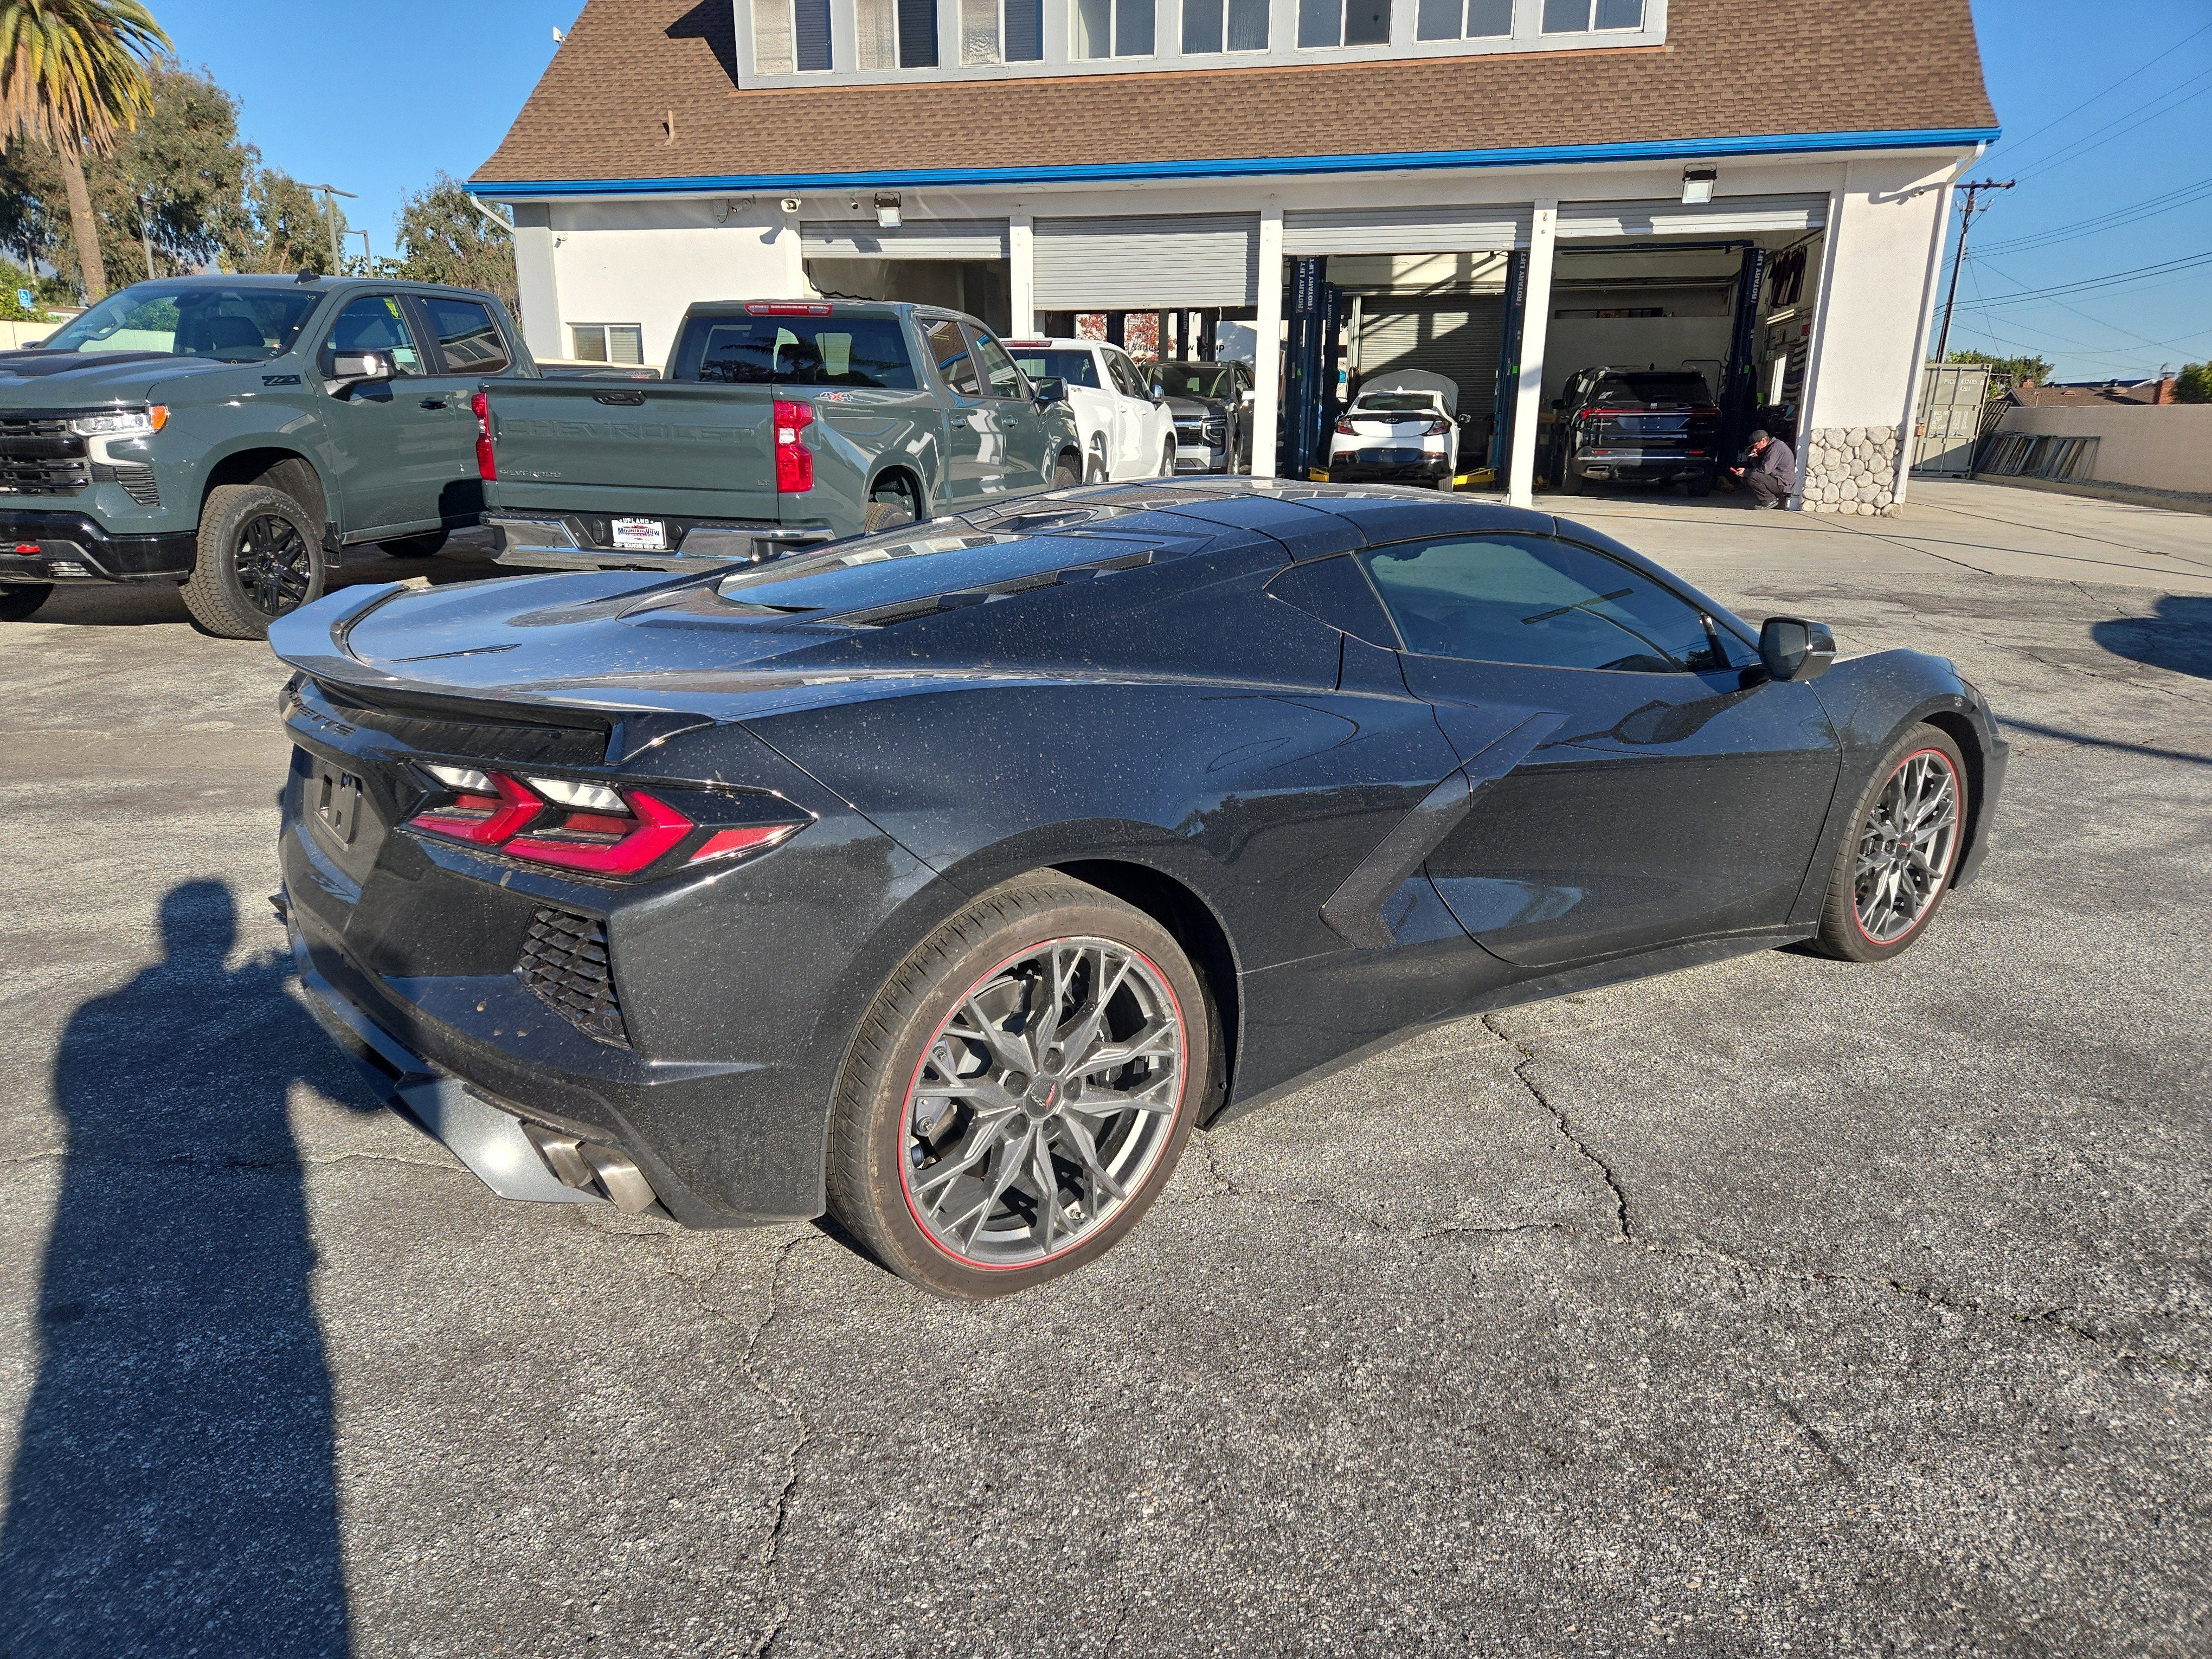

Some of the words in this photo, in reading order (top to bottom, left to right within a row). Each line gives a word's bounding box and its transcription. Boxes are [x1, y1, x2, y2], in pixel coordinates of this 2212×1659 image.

[1516, 270, 1525, 302] ROTARY
[1752, 268, 1761, 299] ROTARY
[505, 420, 753, 442] CHEVROLET
[499, 470, 562, 478] SILVERADO
